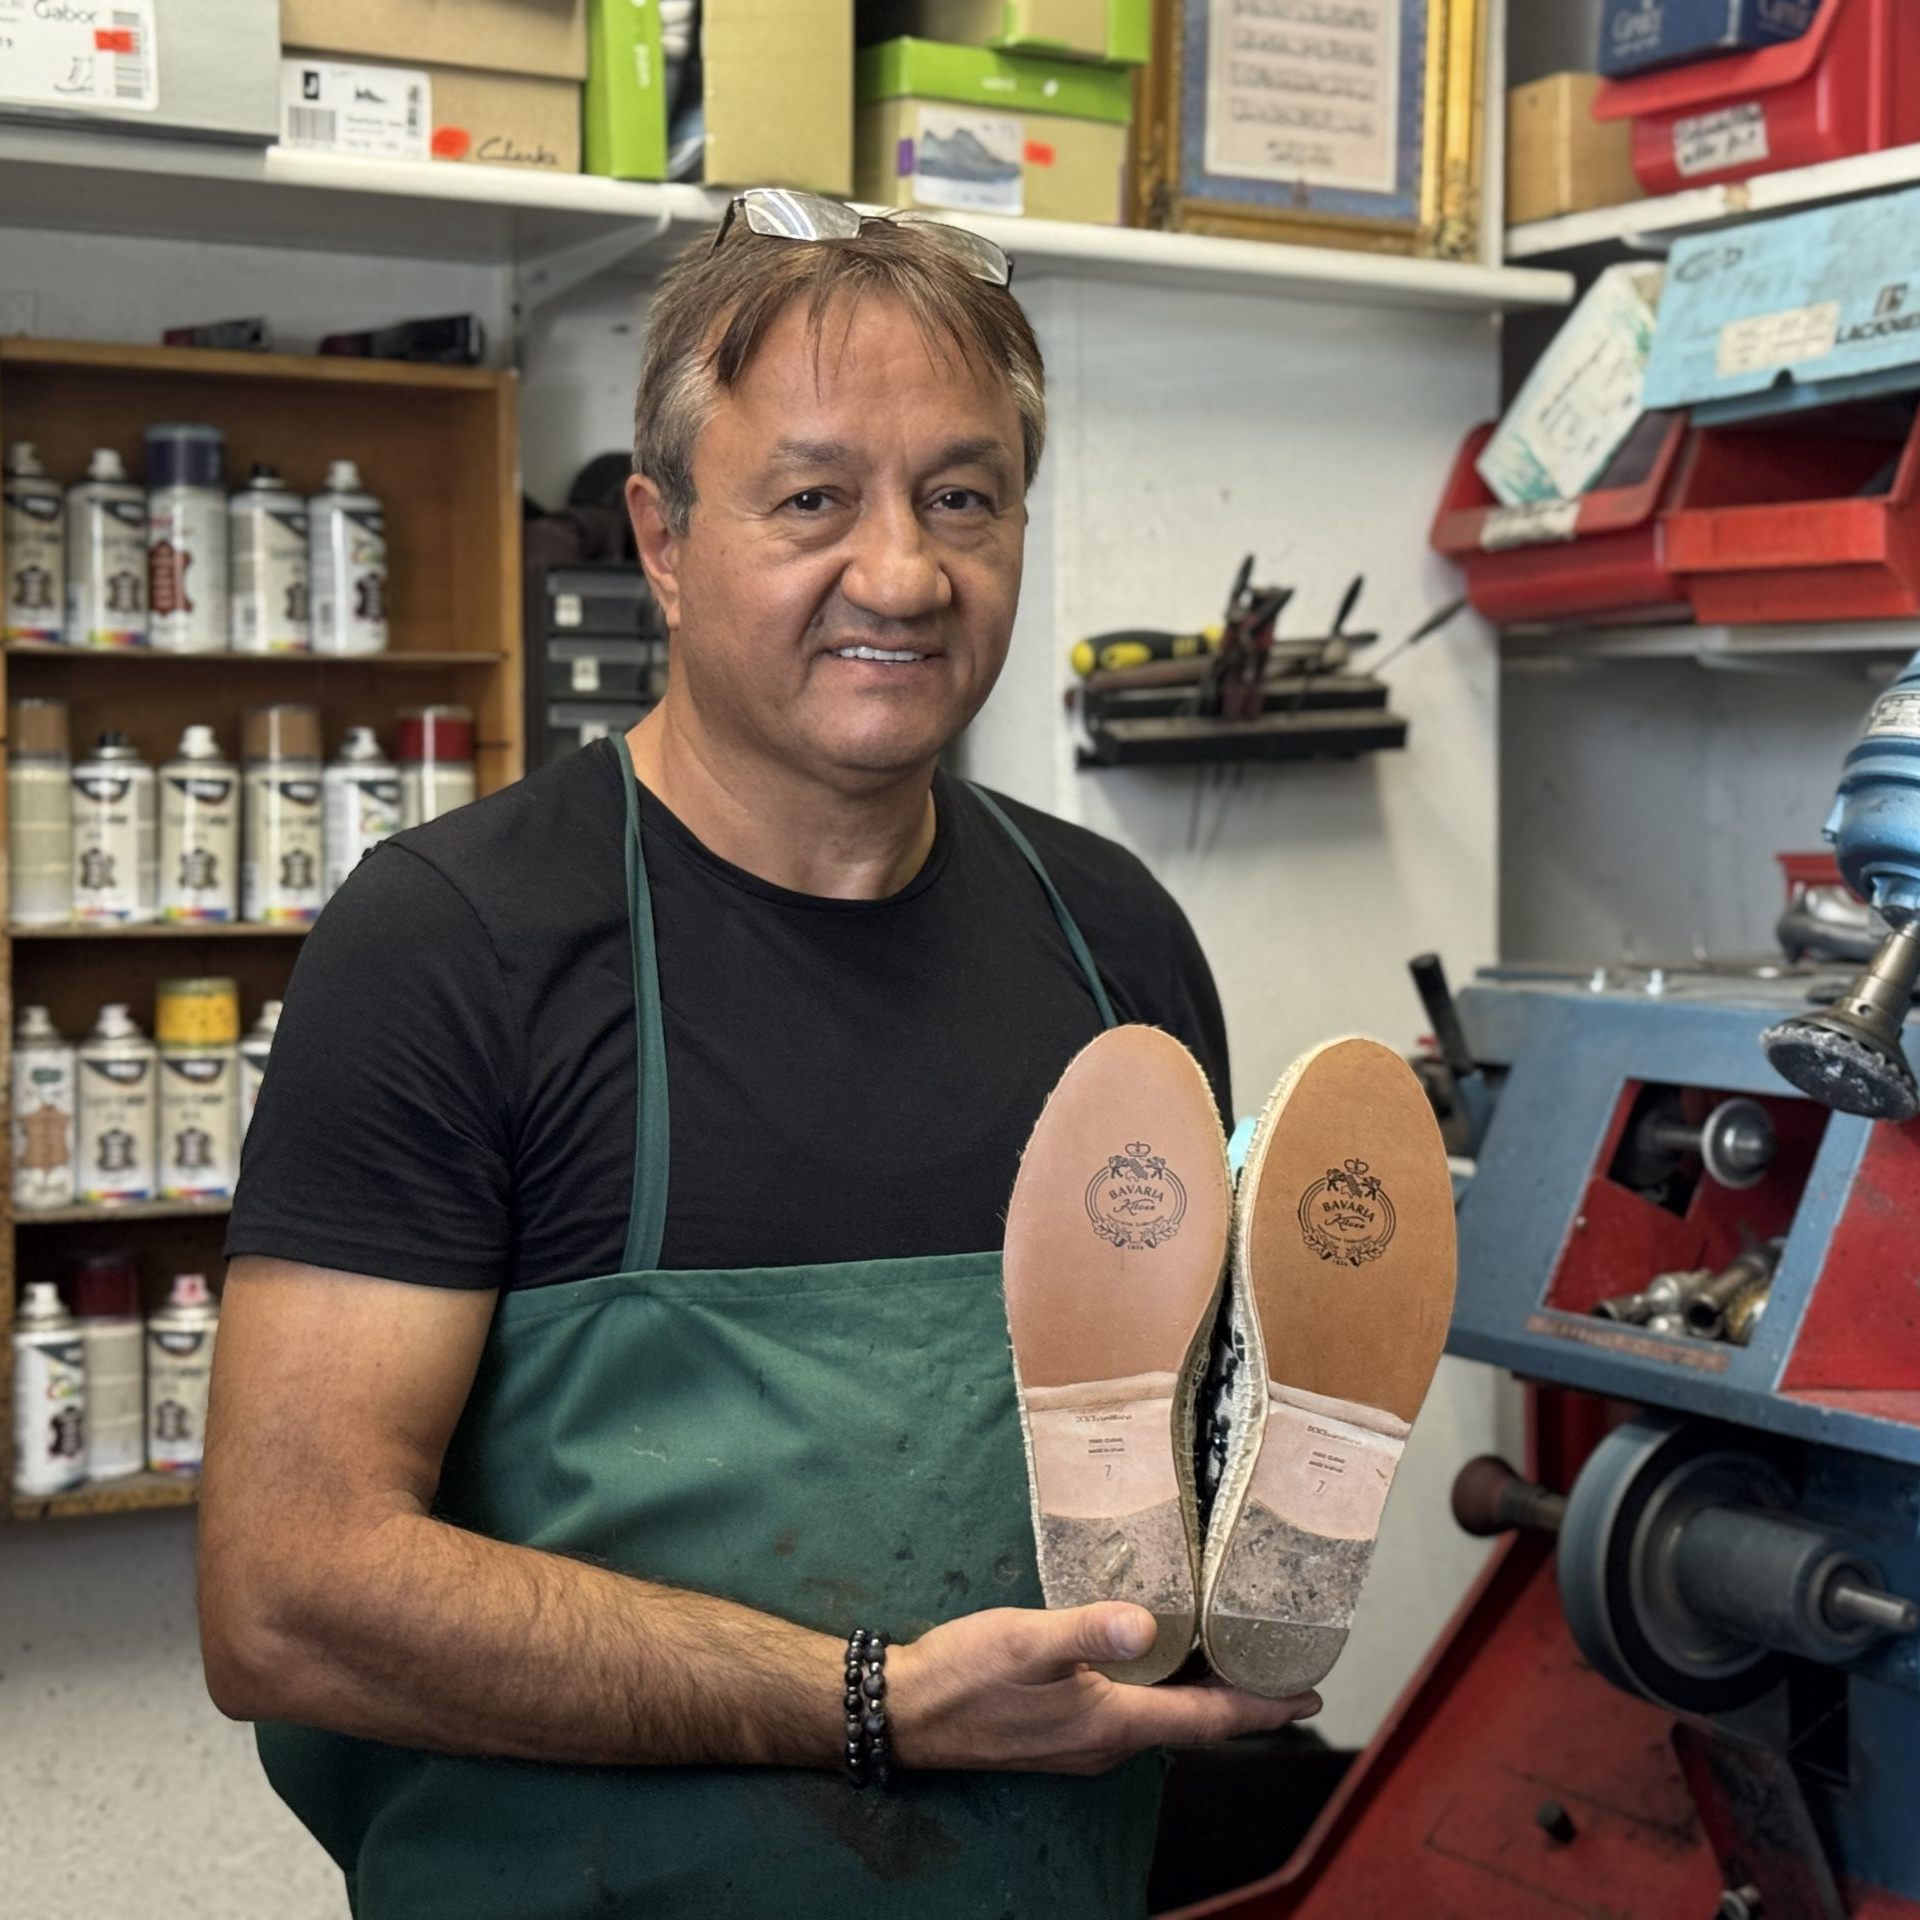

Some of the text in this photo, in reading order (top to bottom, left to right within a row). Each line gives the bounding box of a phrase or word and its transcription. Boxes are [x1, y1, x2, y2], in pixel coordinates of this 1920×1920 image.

[1109, 1185, 1164, 1202] BAVARIA
[1322, 1200, 1375, 1223] BAVARIA
[1104, 1464, 1111, 1478] 7
[1316, 1479, 1325, 1493] 7
